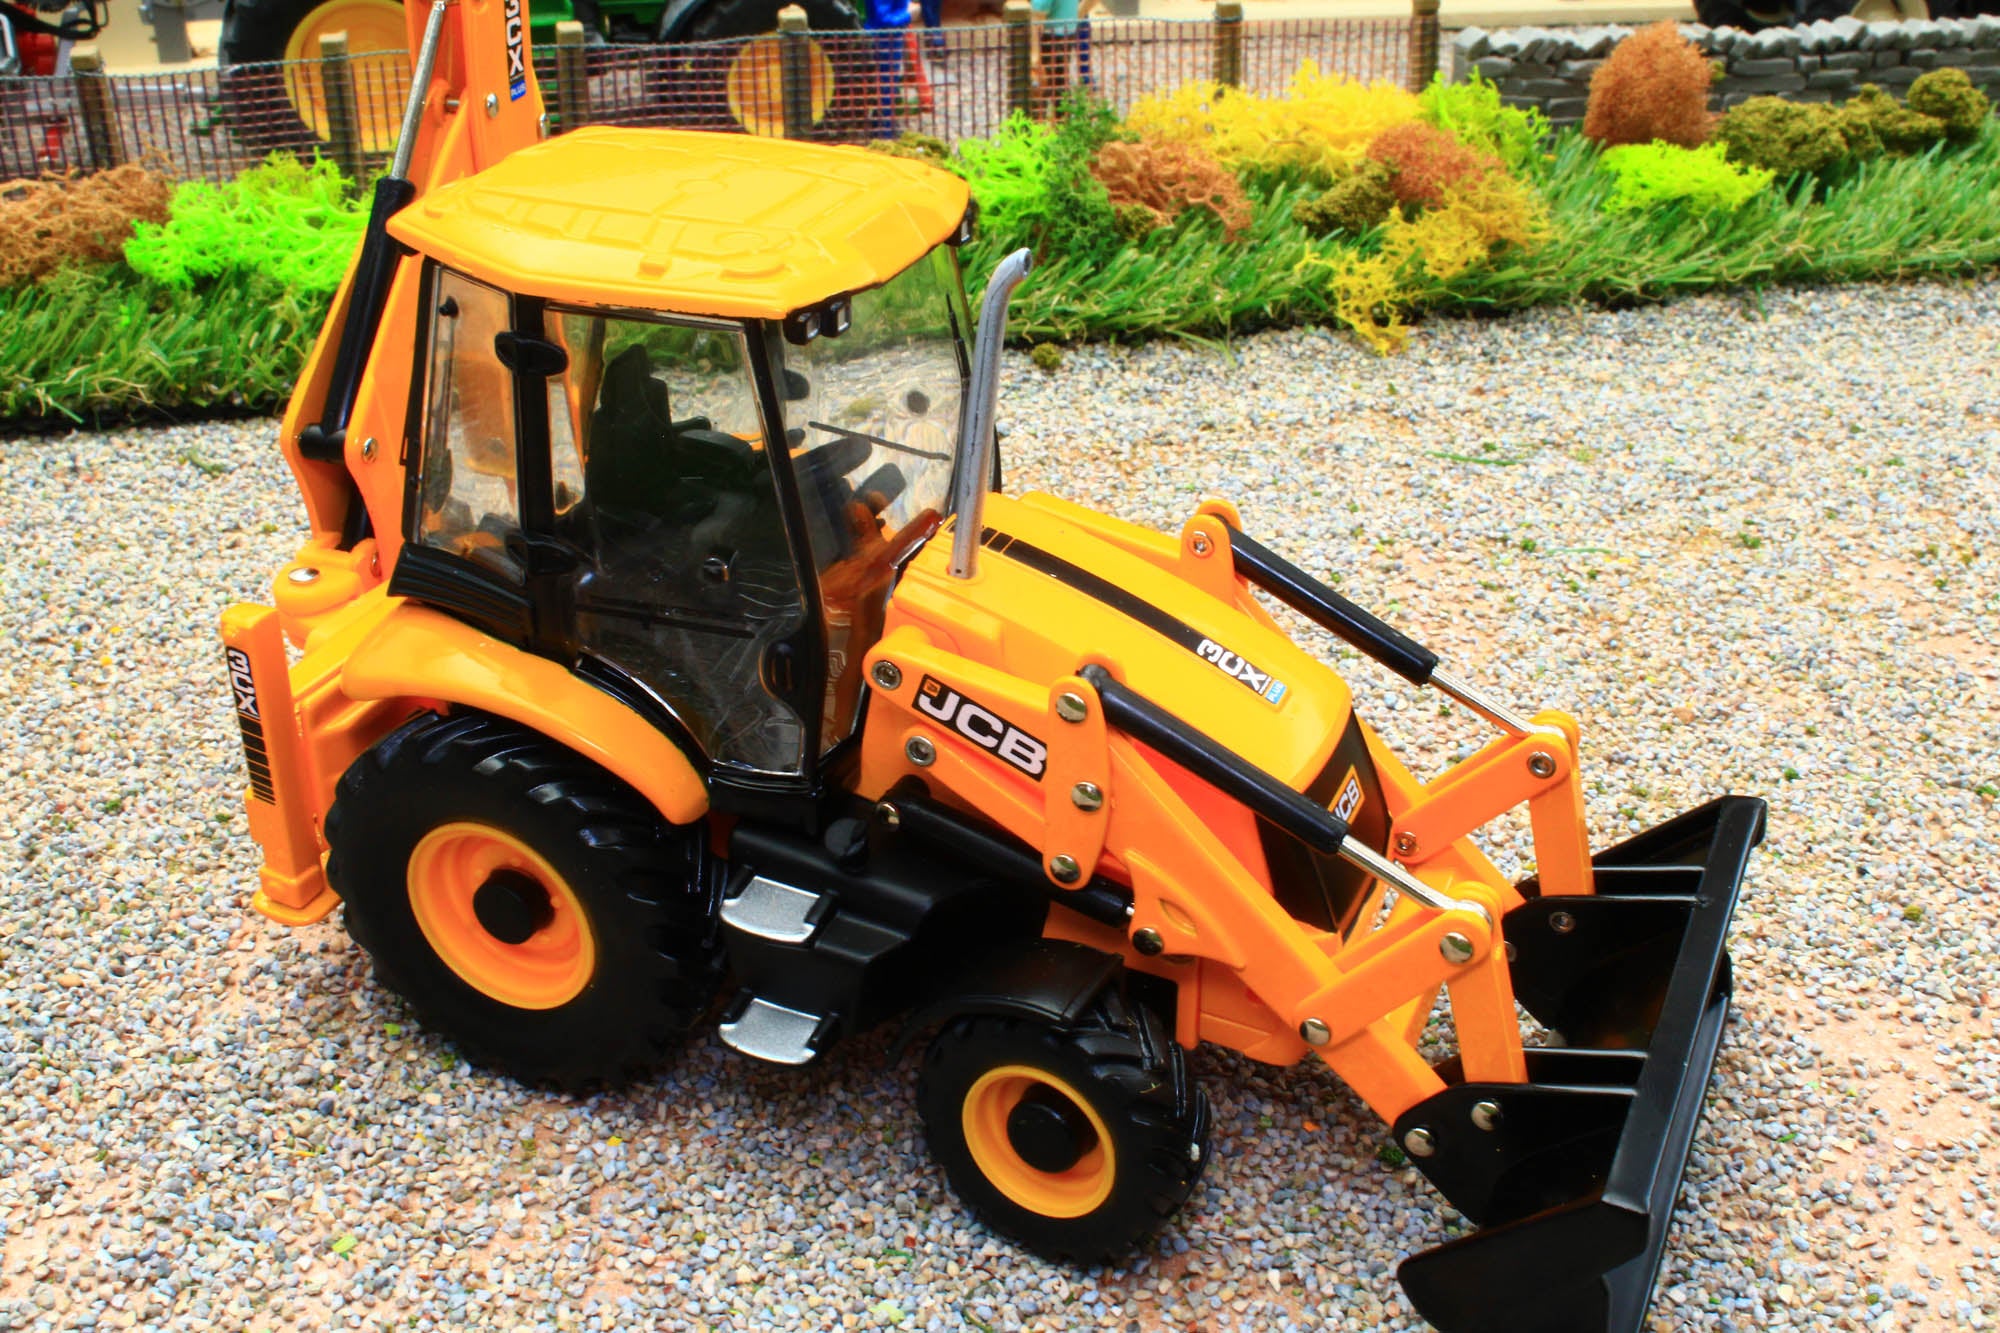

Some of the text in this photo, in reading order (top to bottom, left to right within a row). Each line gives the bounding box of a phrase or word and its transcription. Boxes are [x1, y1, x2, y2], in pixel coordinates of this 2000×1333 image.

[228, 650, 258, 715] 3CX
[1197, 639, 1267, 691] 3CX
[918, 691, 1047, 775] JCB
